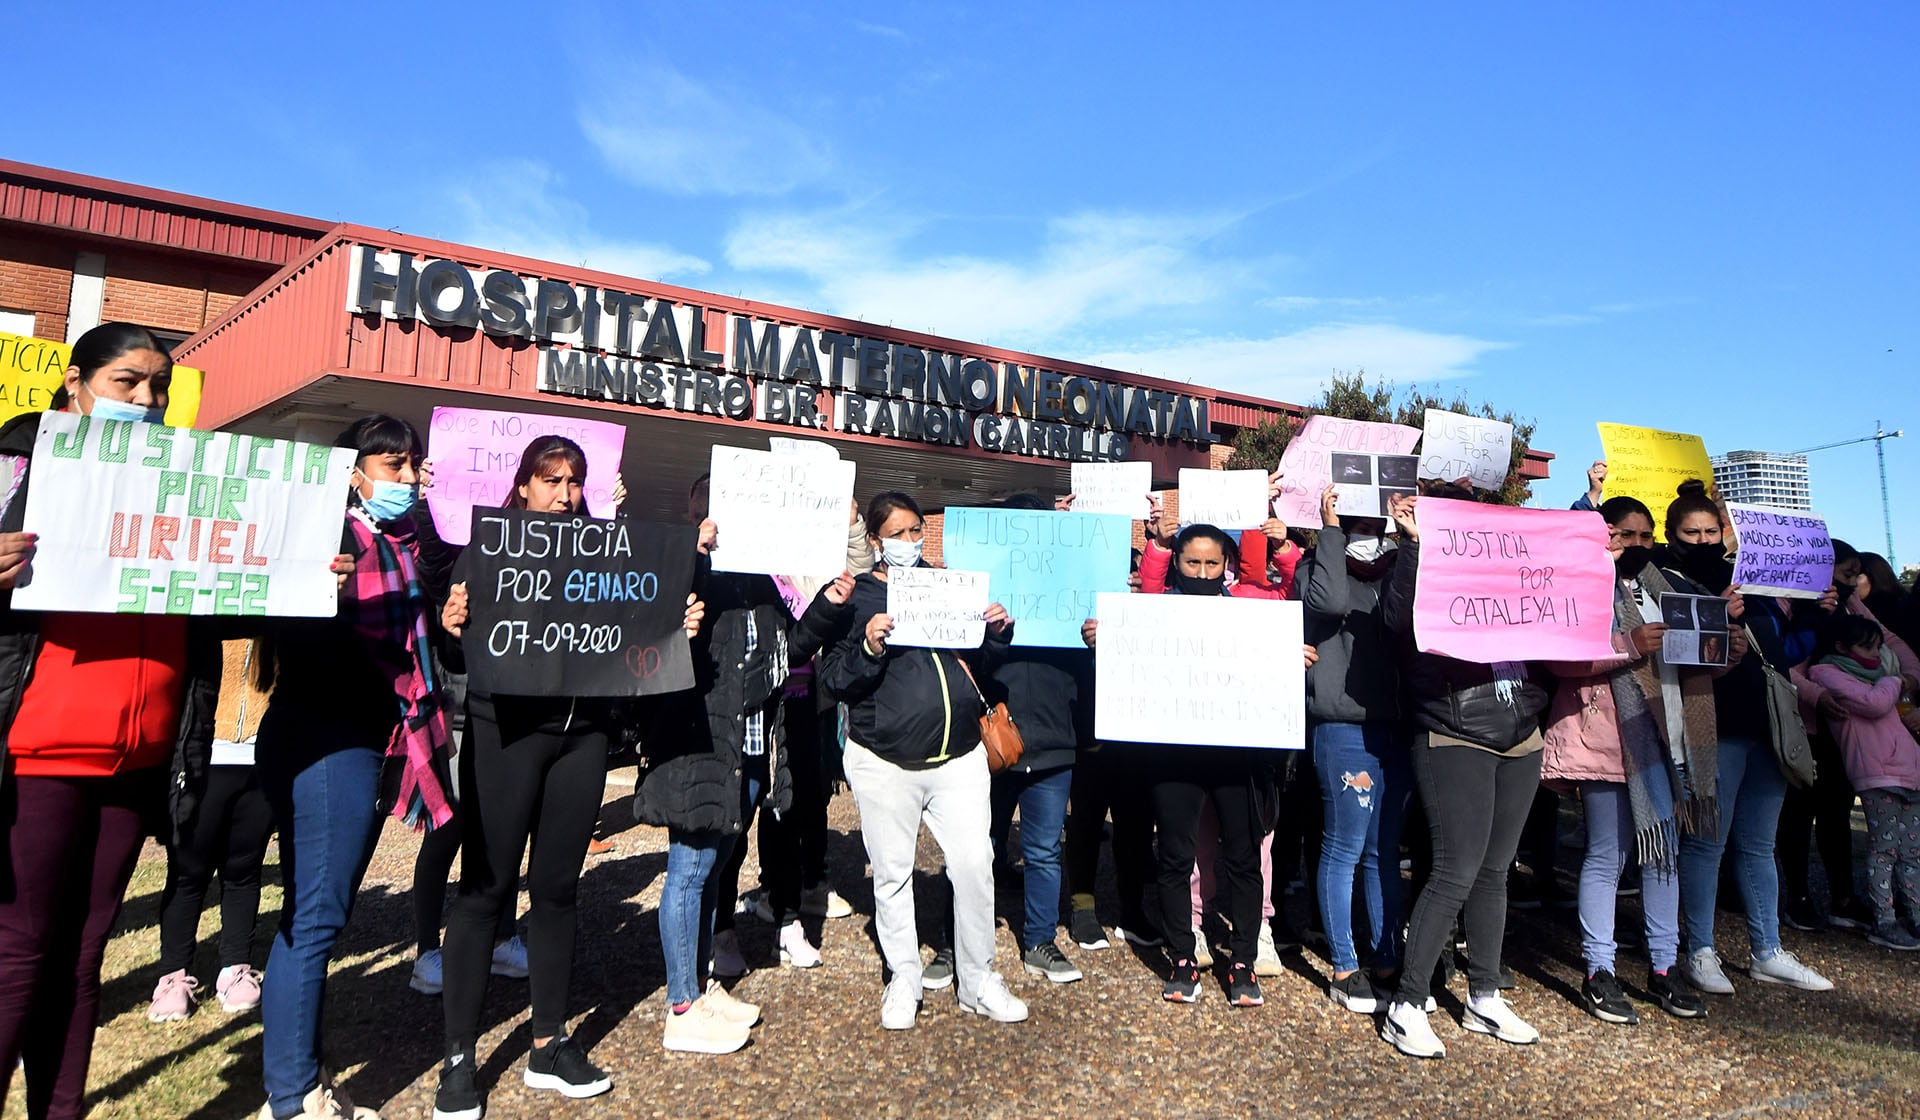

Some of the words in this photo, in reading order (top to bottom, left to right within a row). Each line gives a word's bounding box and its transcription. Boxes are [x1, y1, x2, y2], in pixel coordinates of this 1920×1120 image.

[346, 245, 723, 366] HOSPITAL
[732, 315, 997, 411] MATERNO
[998, 361, 1221, 441] NEONATAL
[538, 347, 751, 420] MINISTRO
[756, 380, 828, 431] DR.
[834, 391, 972, 447] RAMON
[974, 412, 1129, 462] CARRILLO
[491, 416, 522, 437] NO
[1379, 426, 1405, 454] POR
[1427, 412, 1504, 447] JUSTICIA
[52, 416, 332, 484] JUSTICIA
[1459, 441, 1492, 462] POR
[156, 471, 247, 520] POR
[977, 511, 1110, 550] JUSTICIA
[1731, 508, 1770, 526] BASTA
[1774, 514, 1789, 527] DE
[1792, 516, 1828, 531] BEBES
[109, 512, 268, 566] URIEL
[480, 517, 632, 558] JUSTICIA
[1438, 528, 1531, 559] JUSTICIA
[1008, 548, 1055, 580] POR
[1740, 551, 1759, 565] POR
[1764, 551, 1834, 566] PROFESIONALES
[116, 568, 269, 616] 5-6-22
[496, 567, 552, 602] POR
[564, 568, 658, 602] GENARO
[1518, 566, 1554, 590] POR
[1449, 596, 1556, 626] CATALEYA
[1565, 598, 1579, 627] !!
[488, 620, 622, 656] 07-09-2020
